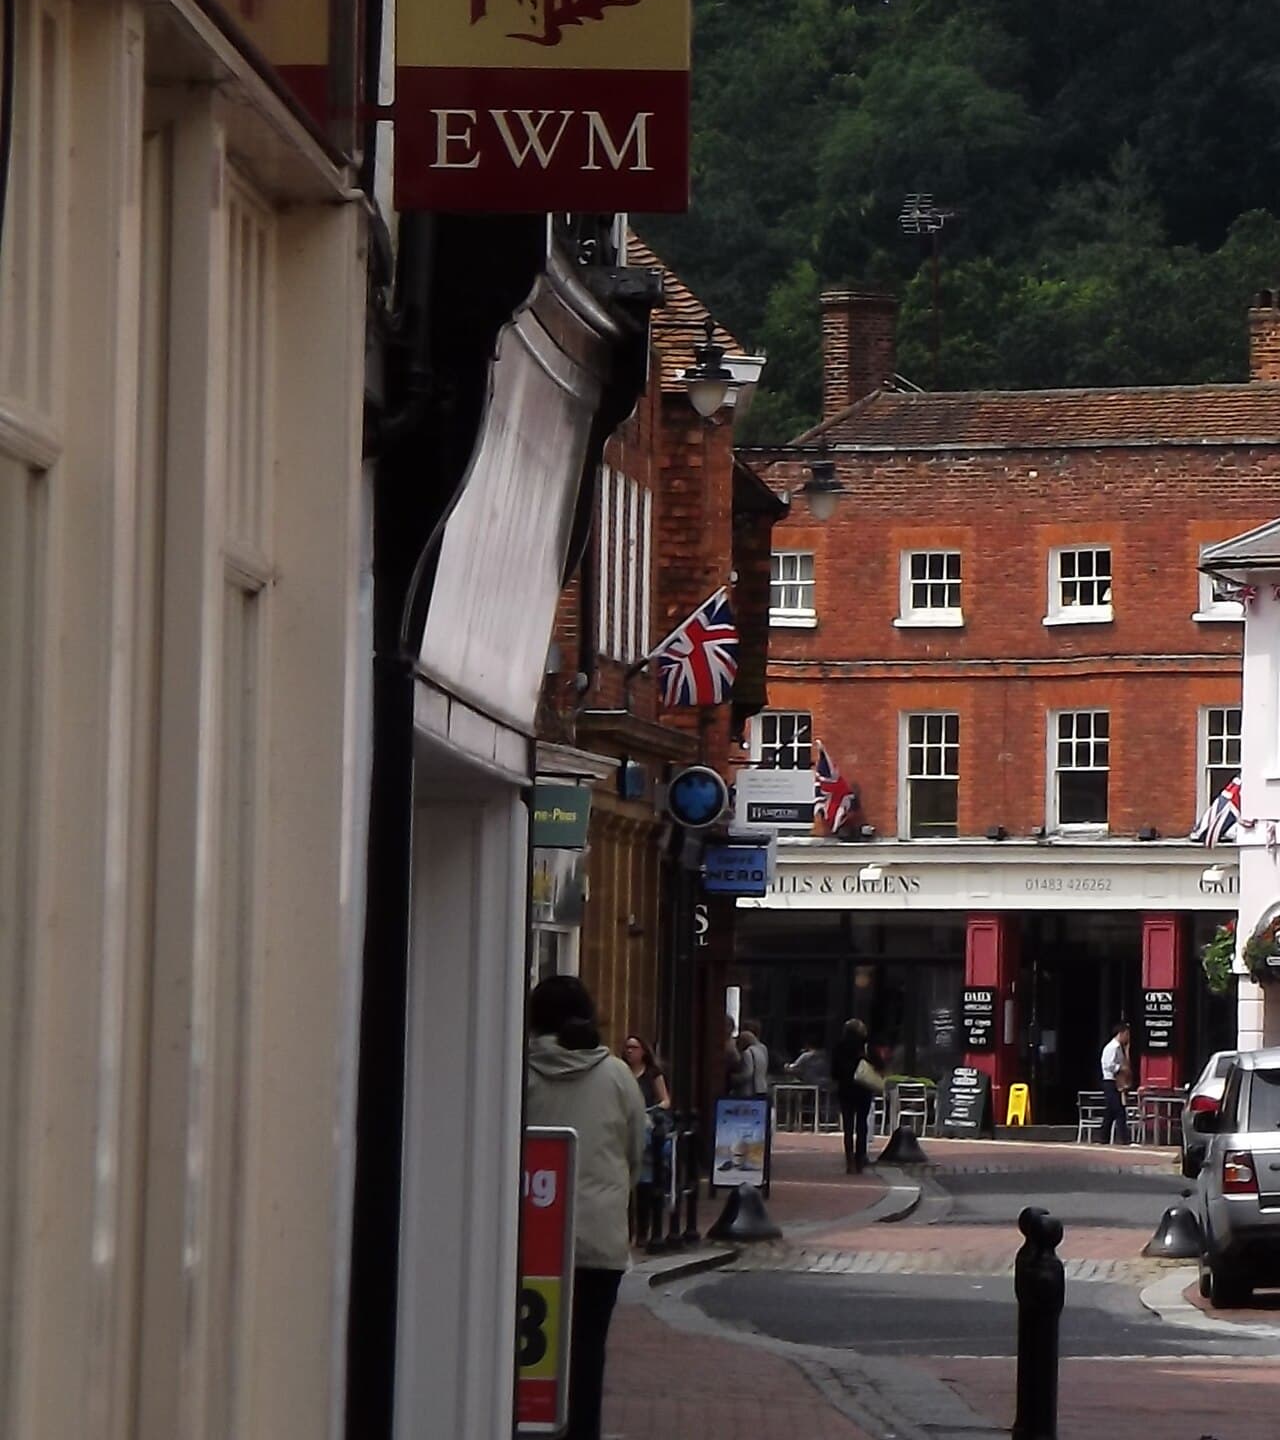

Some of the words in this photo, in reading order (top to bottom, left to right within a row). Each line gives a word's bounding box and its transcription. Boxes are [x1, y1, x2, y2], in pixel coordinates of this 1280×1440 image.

[429, 109, 655, 171] EWM
[709, 869, 765, 881] NERO
[820, 875, 834, 894] &
[1025, 879, 1063, 891] 01483
[1067, 879, 1112, 891] 426262
